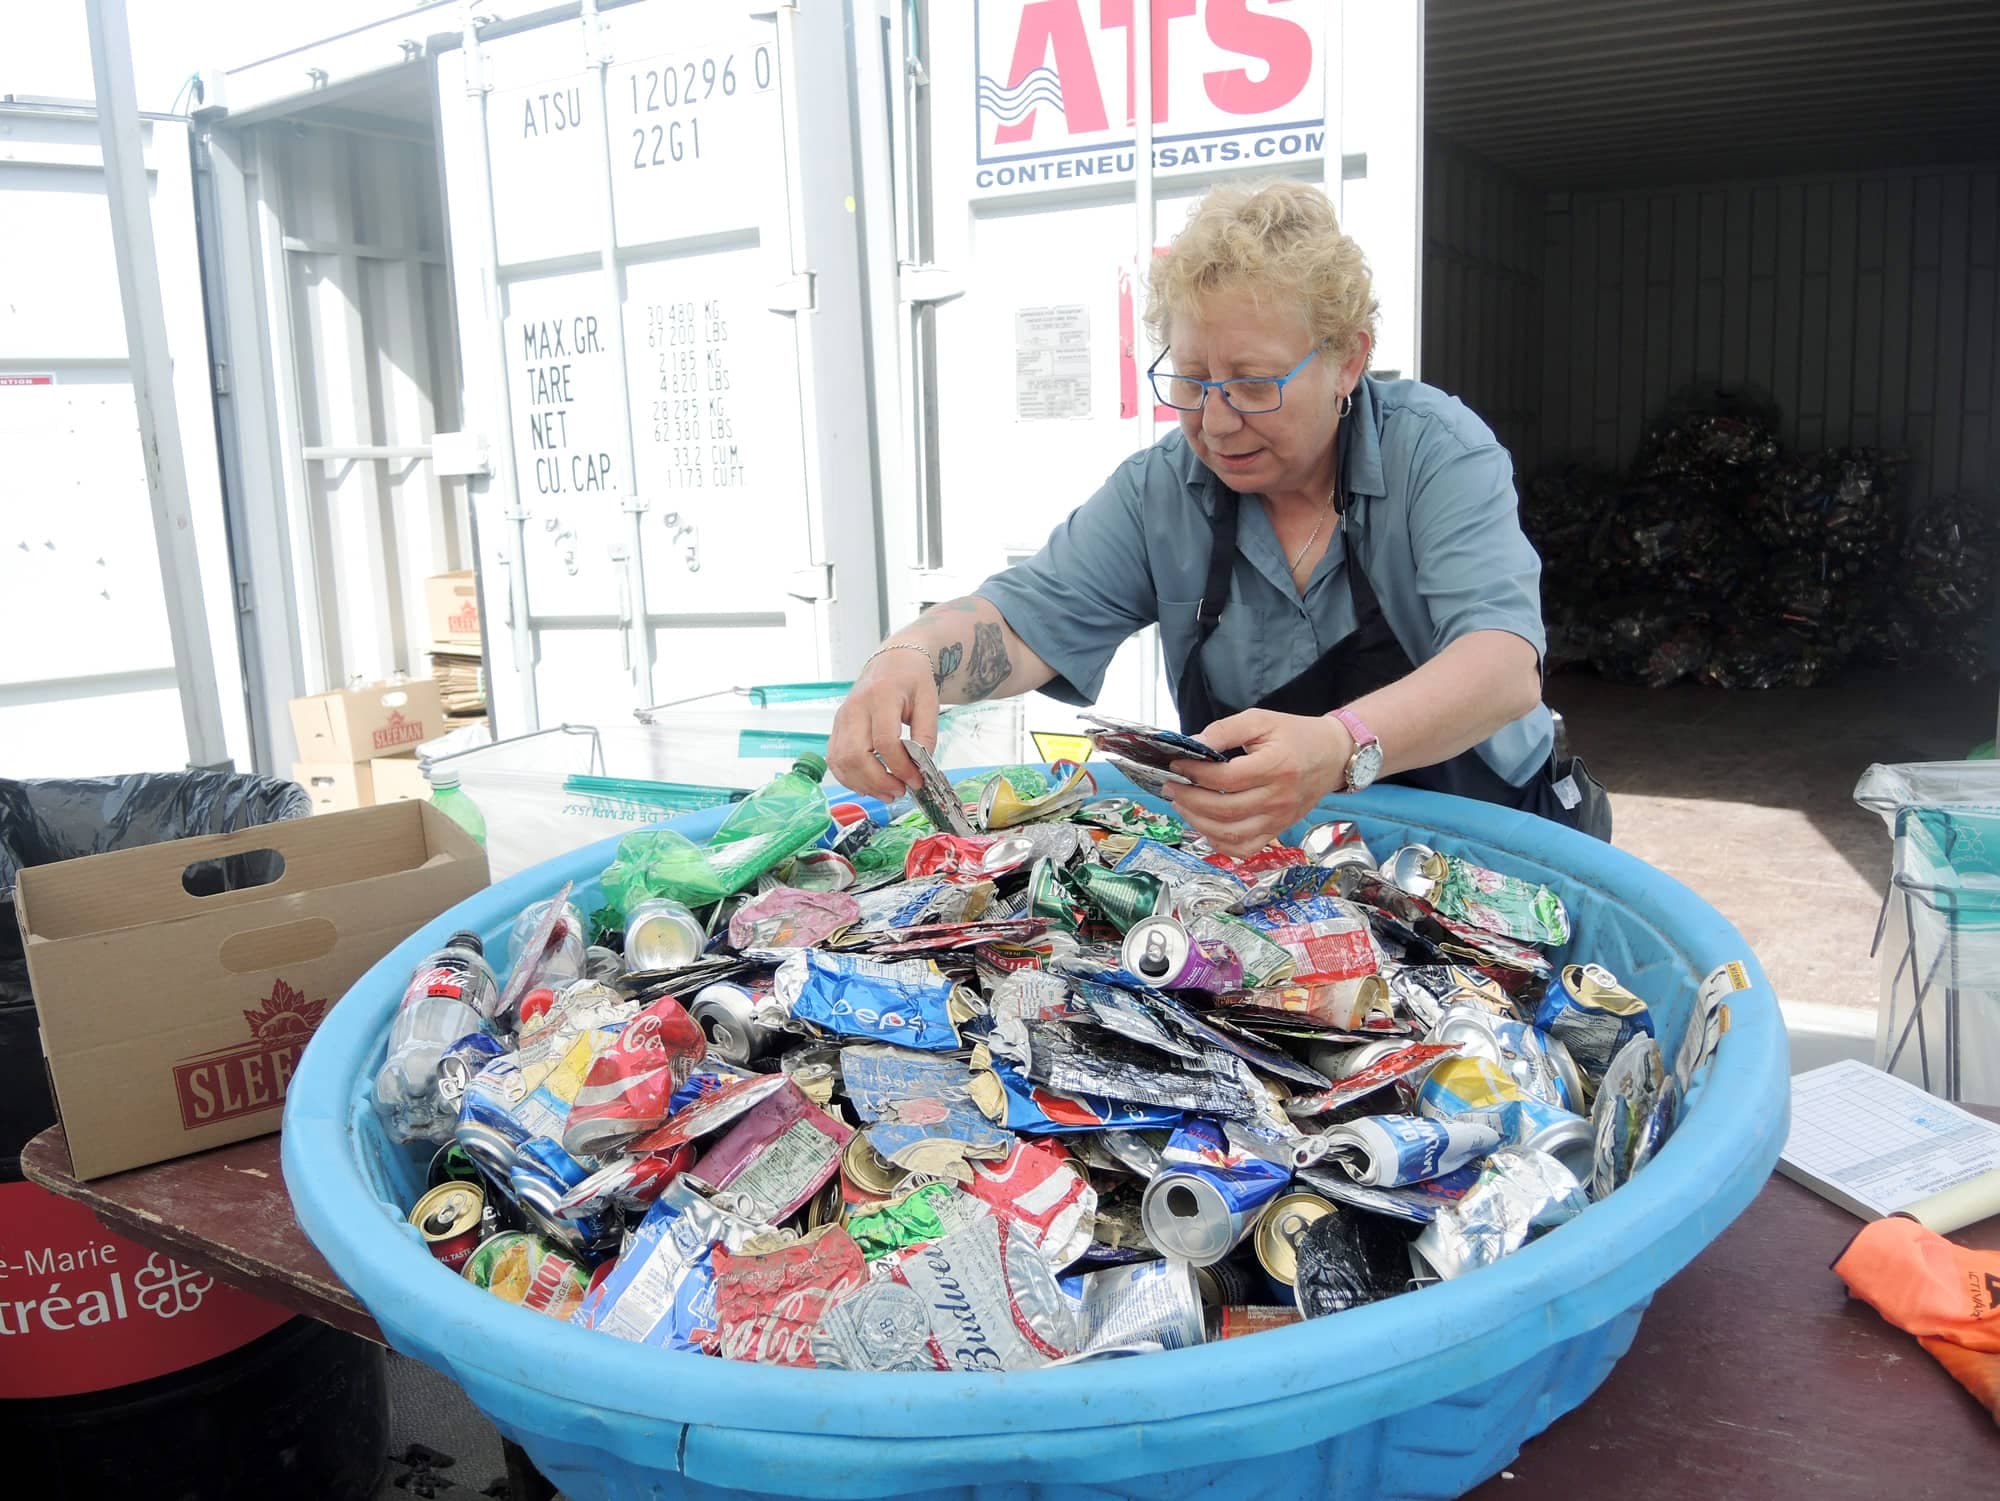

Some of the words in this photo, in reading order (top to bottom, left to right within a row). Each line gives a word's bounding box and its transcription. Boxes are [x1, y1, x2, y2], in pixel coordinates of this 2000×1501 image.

[524, 88, 580, 138] ATSU
[631, 55, 736, 114] 120296
[756, 47, 769, 88] 0
[994, 0, 1312, 145] ATS
[633, 118, 699, 169] 22G1
[976, 130, 1326, 190] CONTENEUSATS.COM
[704, 300, 719, 320] KG
[527, 364, 574, 405] TARE
[706, 348, 723, 369] KG
[530, 411, 566, 450] NET
[709, 397, 726, 416] KG
[536, 453, 616, 494] CU.CAP.
[376, 722, 422, 746] SLEEMAN
[189, 1050, 293, 1119] SLEE
